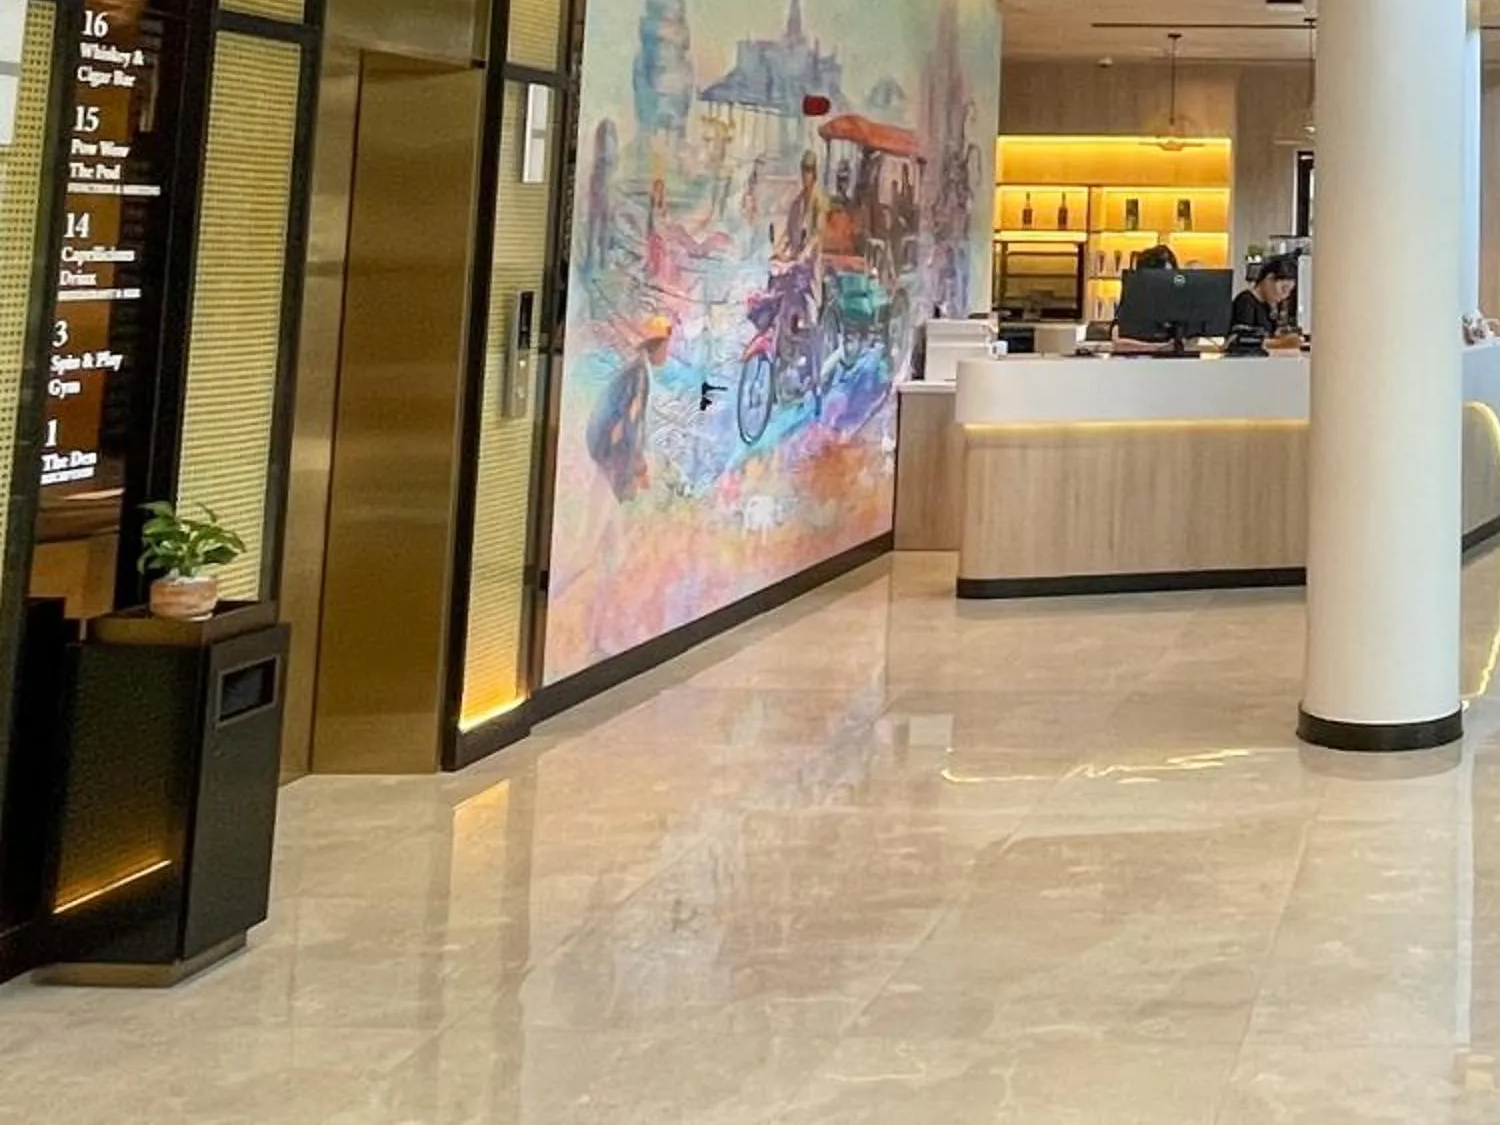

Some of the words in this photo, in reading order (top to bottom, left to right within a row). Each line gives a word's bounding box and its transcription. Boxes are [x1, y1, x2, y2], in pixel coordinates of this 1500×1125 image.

[83, 11, 108, 37] 16
[80, 43, 131, 67] Whiskey
[133, 51, 143, 65] &
[78, 66, 112, 87] Cigar
[75, 106, 99, 131] 15
[70, 163, 94, 179] The
[64, 213, 89, 238] 14
[53, 321, 68, 347] 3
[51, 355, 80, 375] Spin
[82, 353, 94, 368] &
[96, 351, 122, 370] Play
[48, 379, 80, 399] Gym
[46, 420, 56, 447] 1
[41, 453, 68, 472] The
